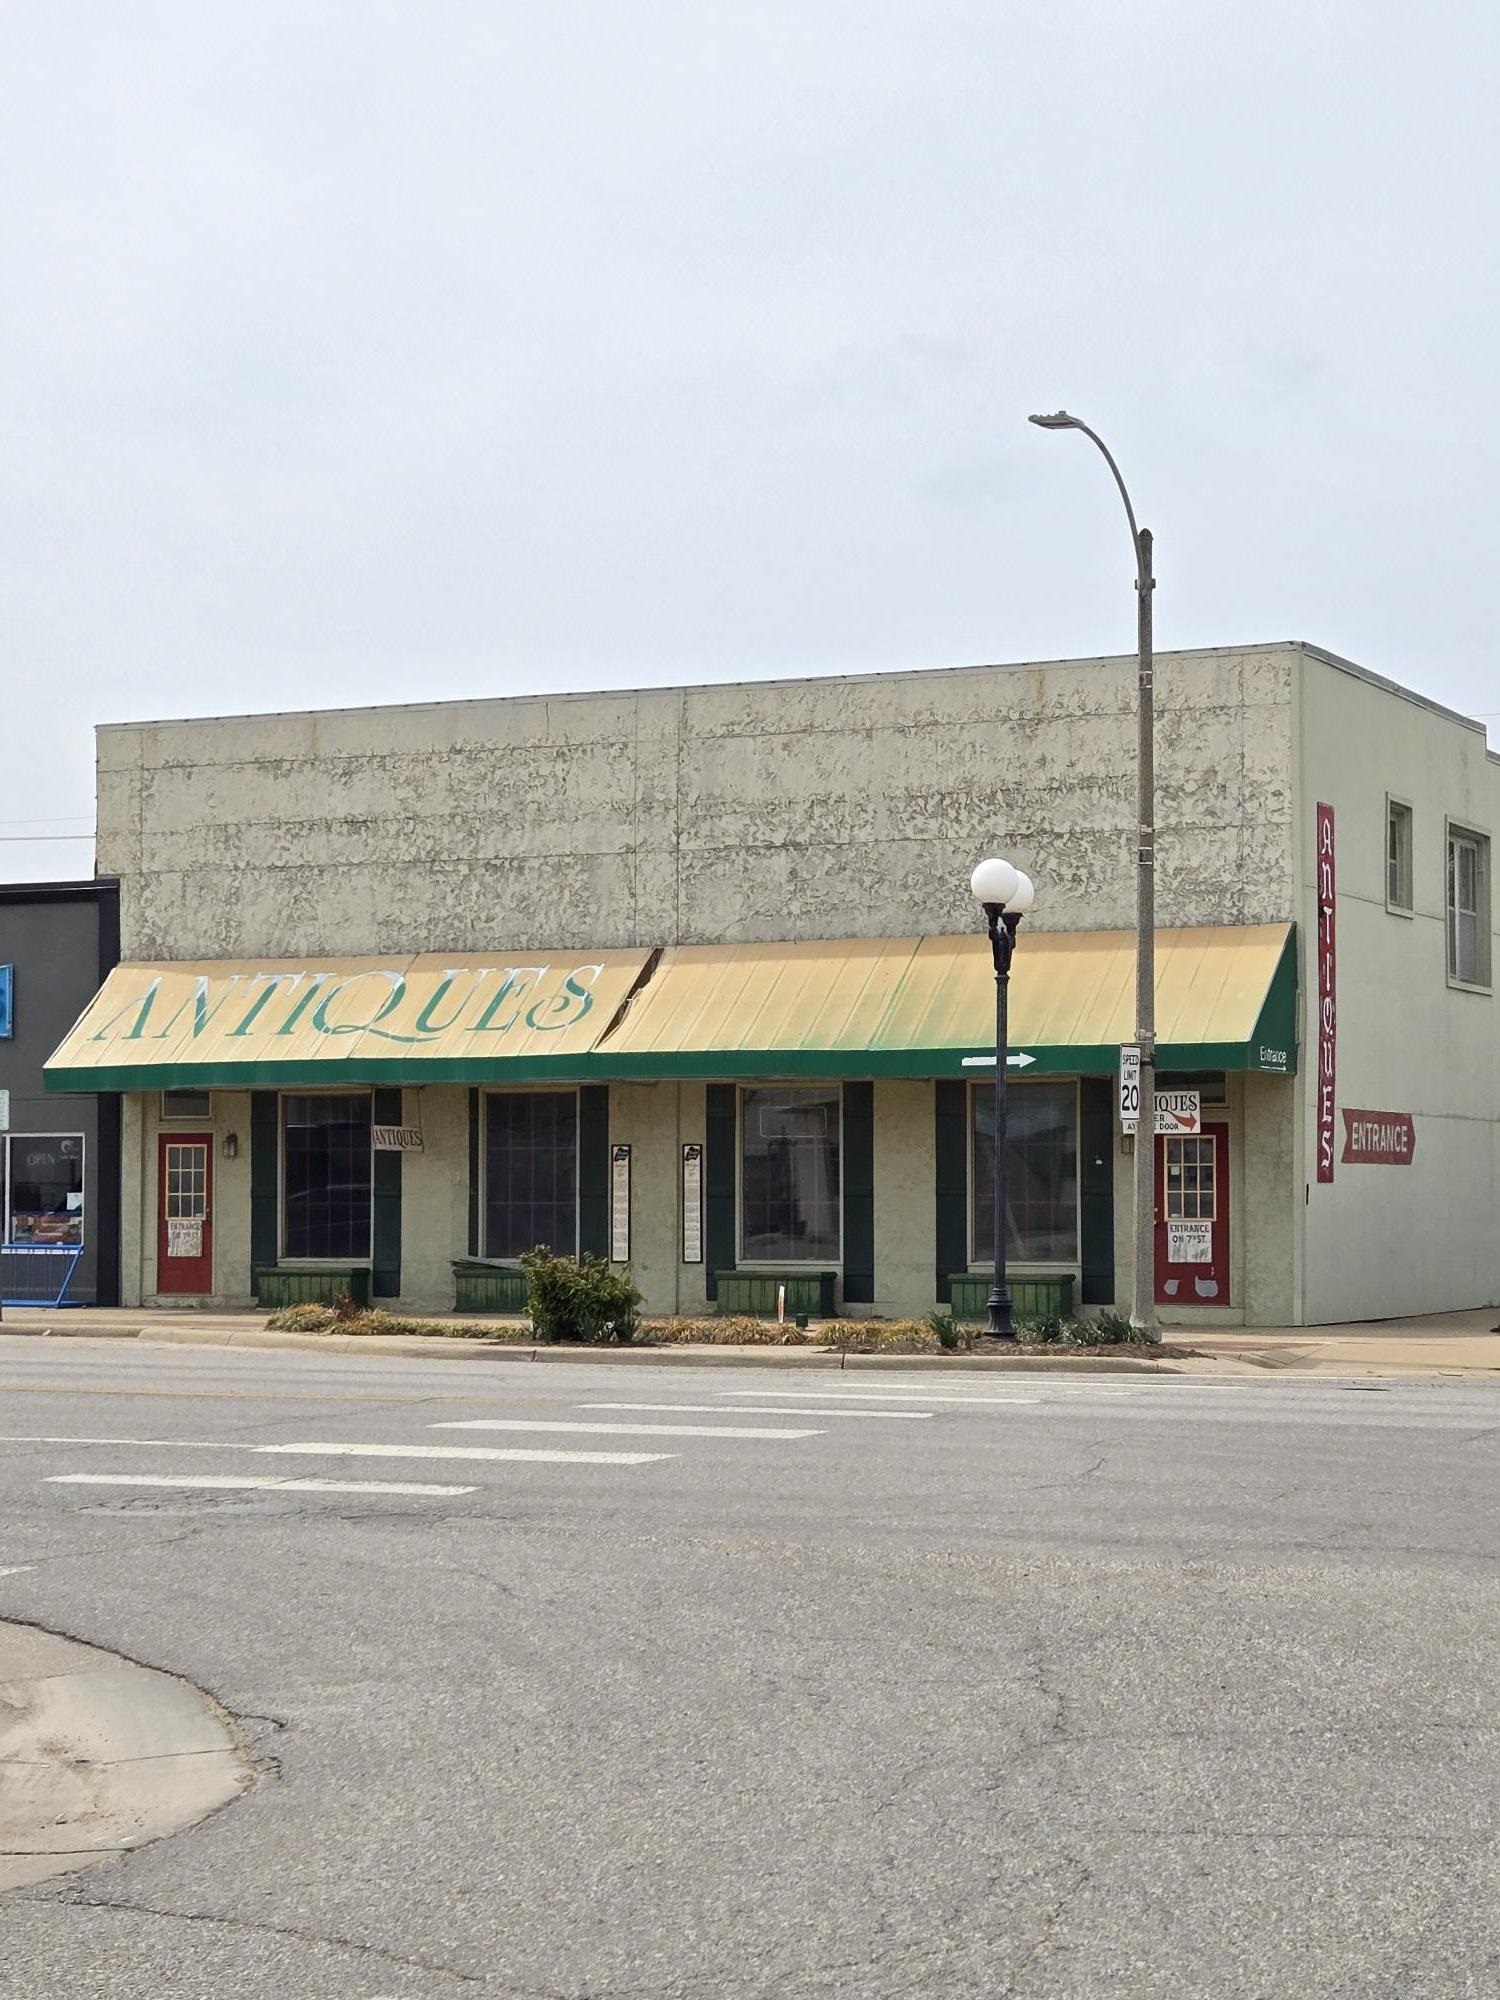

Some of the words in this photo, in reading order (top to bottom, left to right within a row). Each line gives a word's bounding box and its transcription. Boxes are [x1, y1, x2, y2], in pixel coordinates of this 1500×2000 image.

[1321, 818, 1333, 1168] ANTIQUES
[88, 963, 605, 1042] ANTIQUES
[1122, 1054, 1139, 1066] SPEED
[1260, 1045, 1287, 1063] Entrance
[1123, 1069, 1137, 1081] LIMIT
[1121, 1085, 1139, 1111] 20
[1154, 1094, 1198, 1112] IQUES
[1159, 1122, 1179, 1131] DOOR
[374, 1128, 422, 1149] ANTIQUES
[1351, 1121, 1408, 1153] ENTRANCE
[1170, 1224, 1210, 1233] ENTRANCE
[1172, 1234, 1184, 1244] ON
